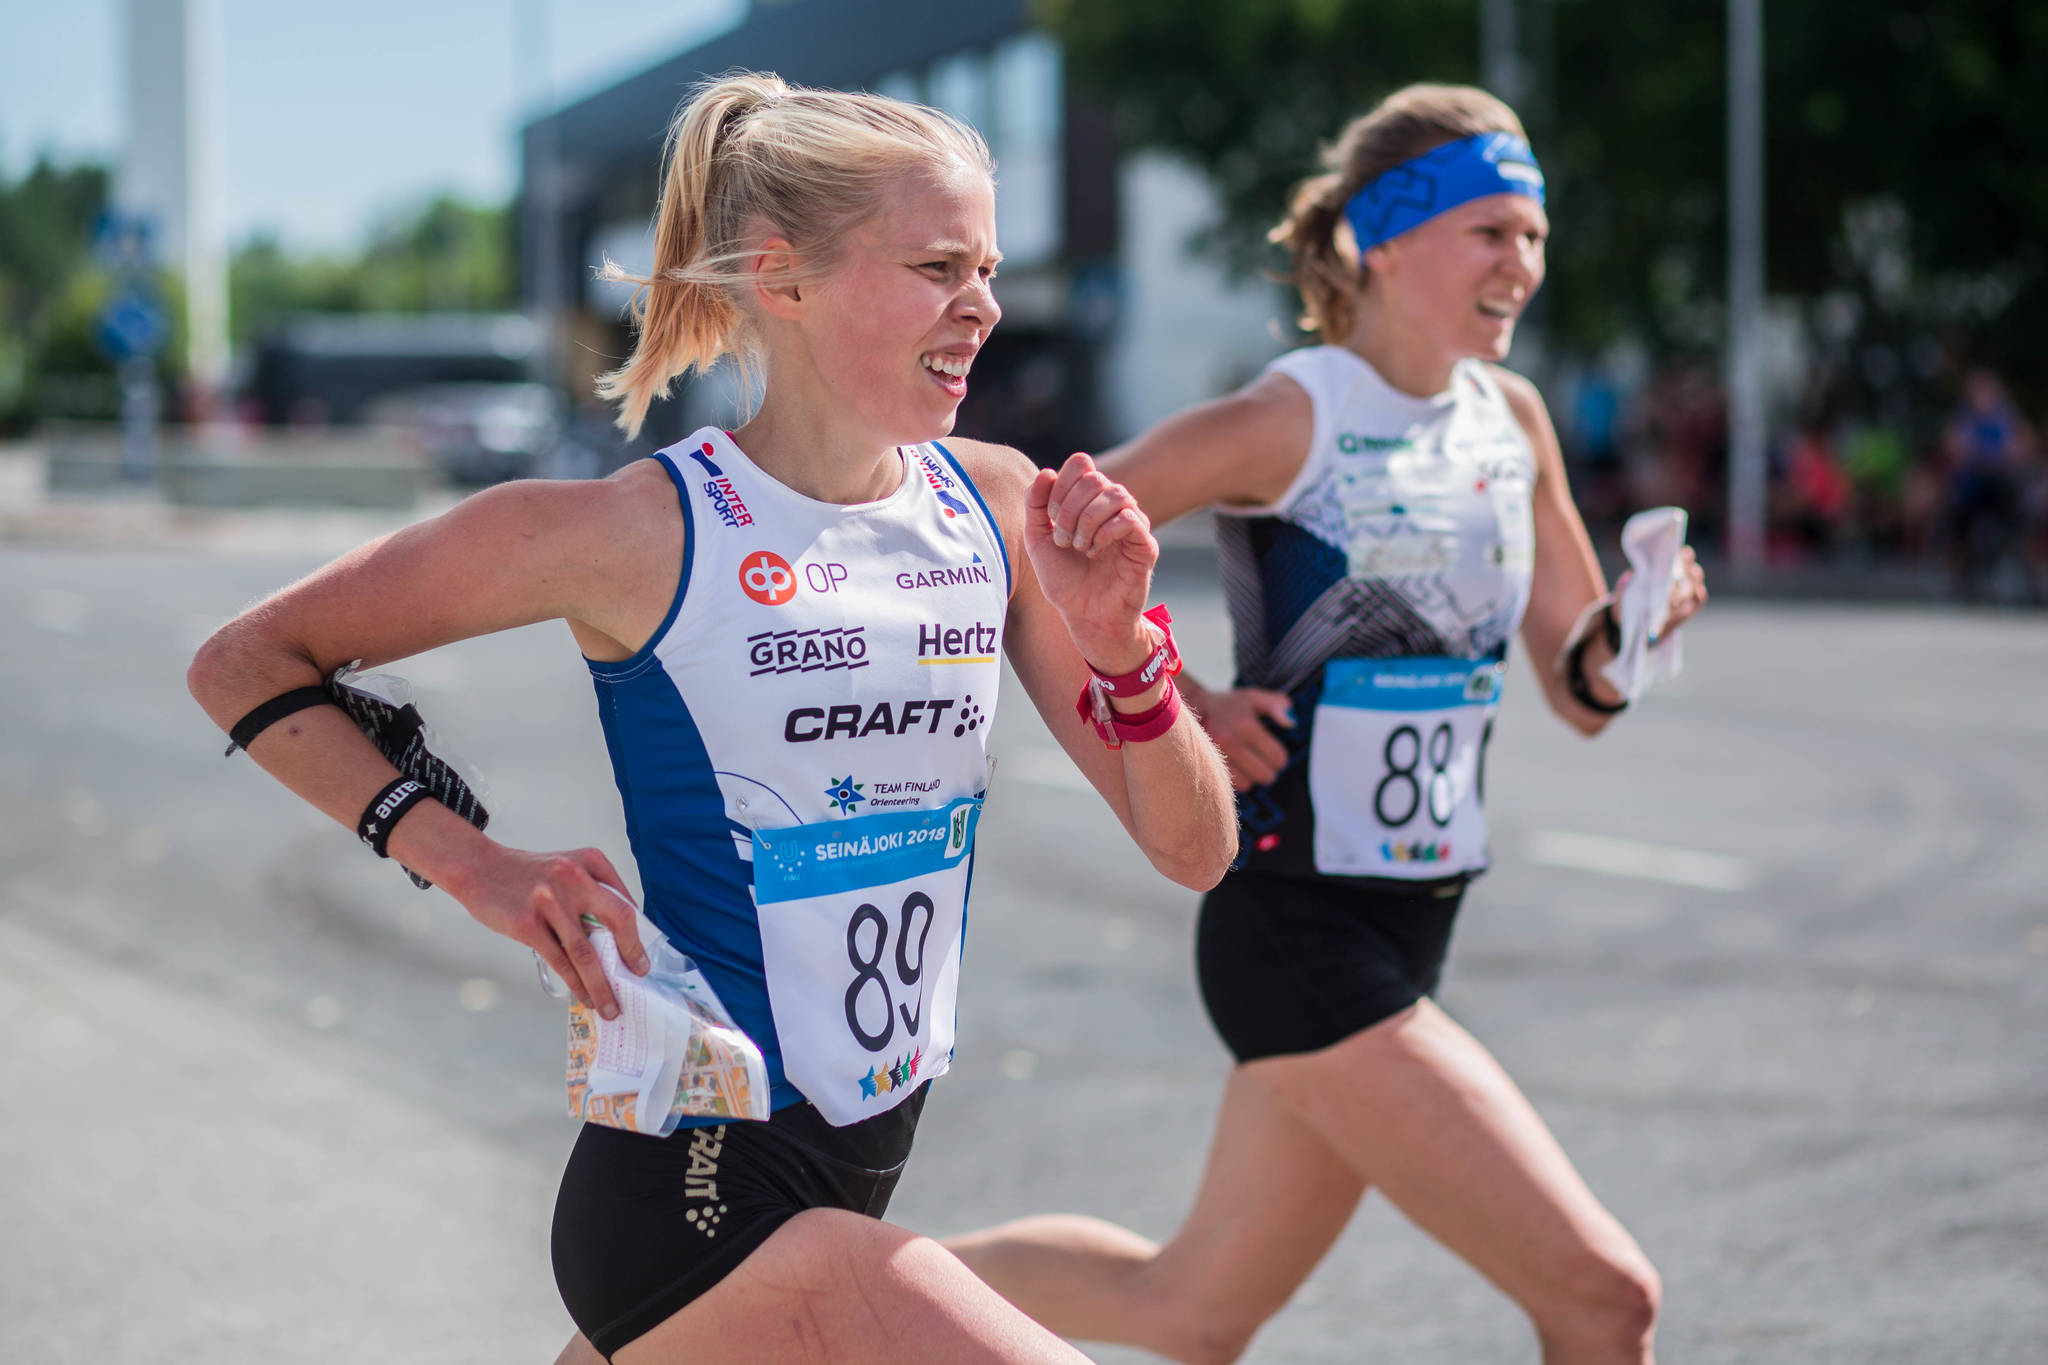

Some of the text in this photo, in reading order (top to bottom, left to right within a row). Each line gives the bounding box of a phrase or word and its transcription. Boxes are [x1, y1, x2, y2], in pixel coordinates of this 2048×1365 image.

[703, 481, 739, 528] SPORT
[715, 478, 752, 526] INTER
[805, 563, 848, 593] OP
[750, 636, 866, 667] GRANO
[918, 622, 996, 656] Hertz
[784, 699, 955, 743] CRAFT
[874, 782, 902, 794] TEAM
[1373, 722, 1453, 828] 88
[870, 797, 921, 807] Orienteering
[815, 832, 903, 861] SEINÄJOKI
[906, 827, 947, 846] 2018
[845, 891, 934, 1052] 89
